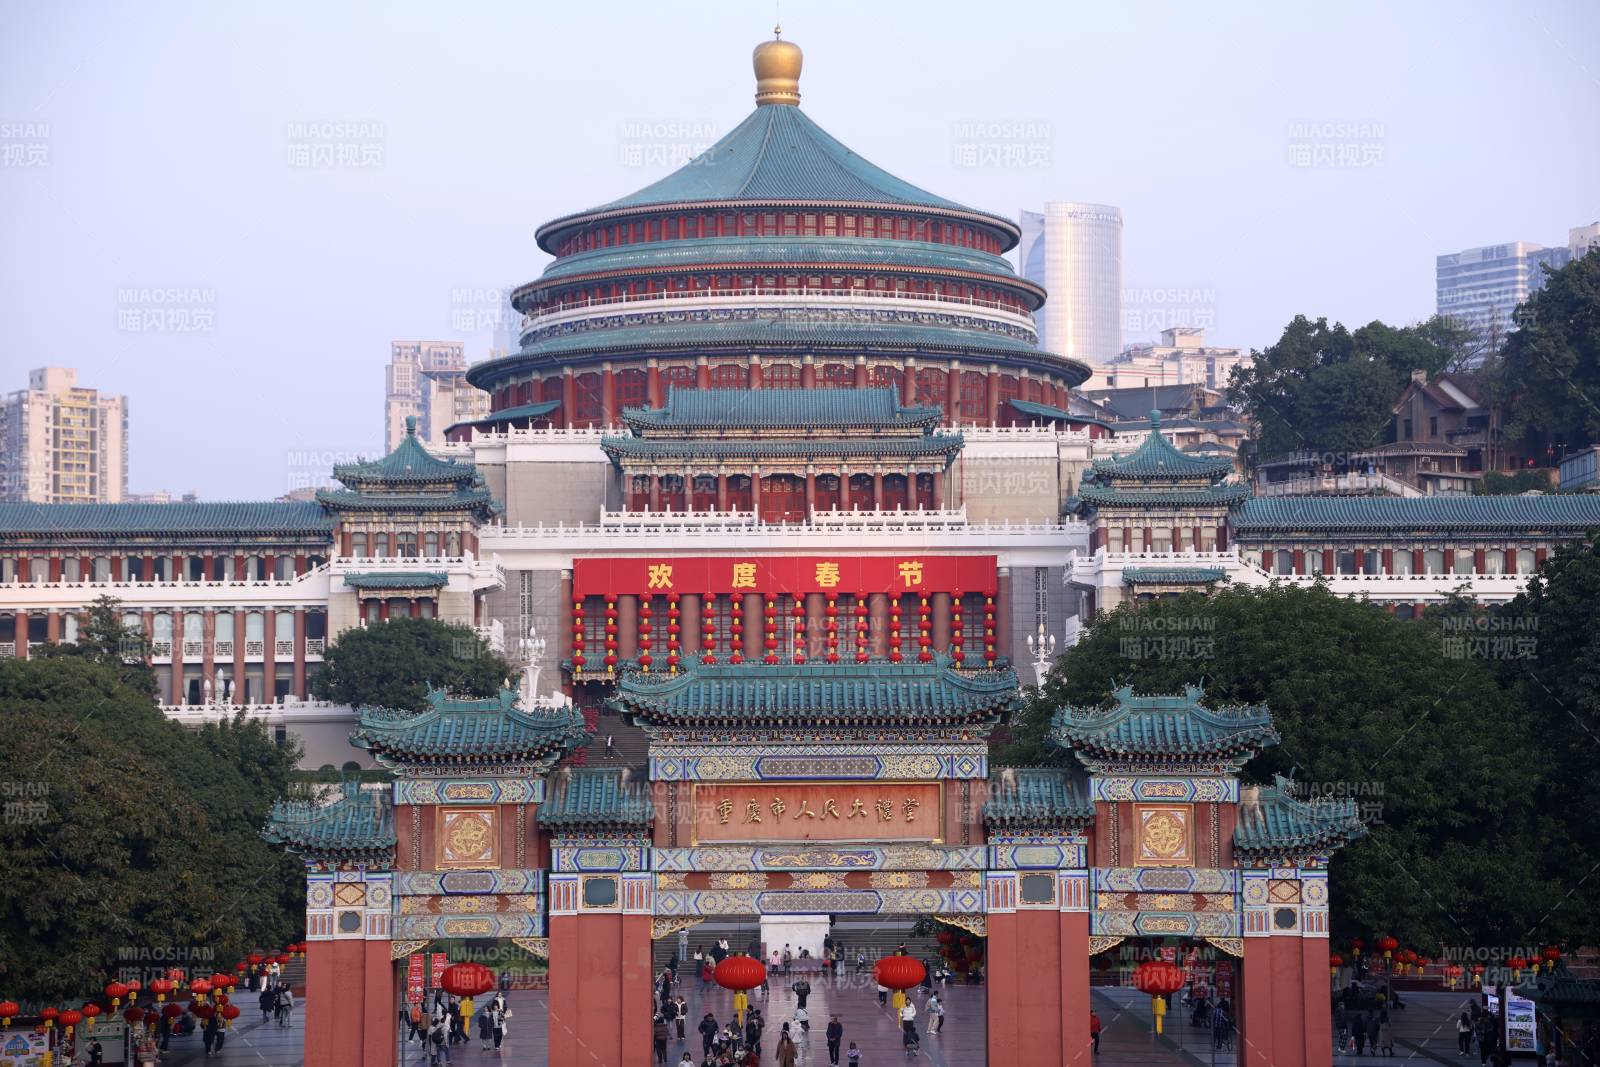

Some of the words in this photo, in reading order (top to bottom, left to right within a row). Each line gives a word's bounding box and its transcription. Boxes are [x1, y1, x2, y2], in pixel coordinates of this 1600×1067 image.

[648, 561, 923, 589] 欢度春节
[716, 797, 920, 825] 重慶市人民大禮堂
